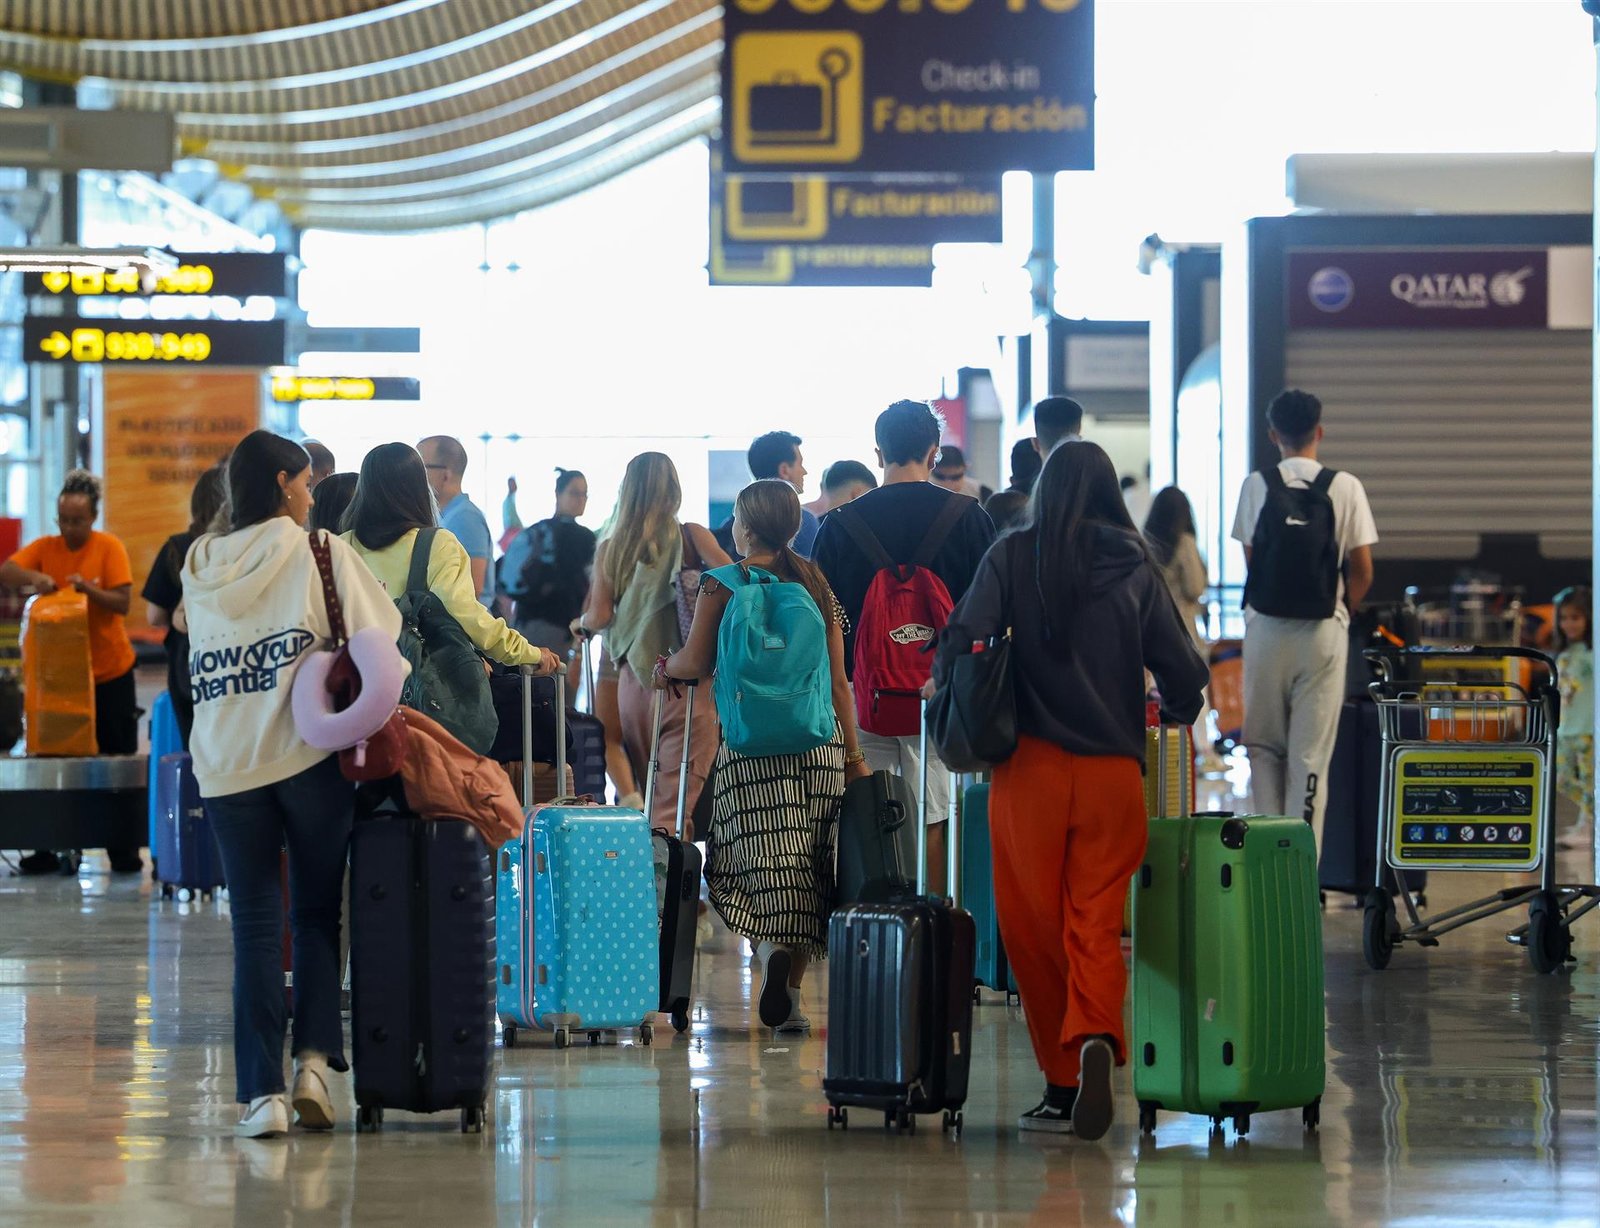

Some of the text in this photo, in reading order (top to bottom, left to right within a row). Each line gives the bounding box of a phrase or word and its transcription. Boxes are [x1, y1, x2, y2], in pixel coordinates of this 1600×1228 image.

[921, 58, 1041, 93] Check-in
[872, 95, 1087, 133] Facturación
[1391, 273, 1487, 303] QATAR
[249, 636, 311, 671] your
